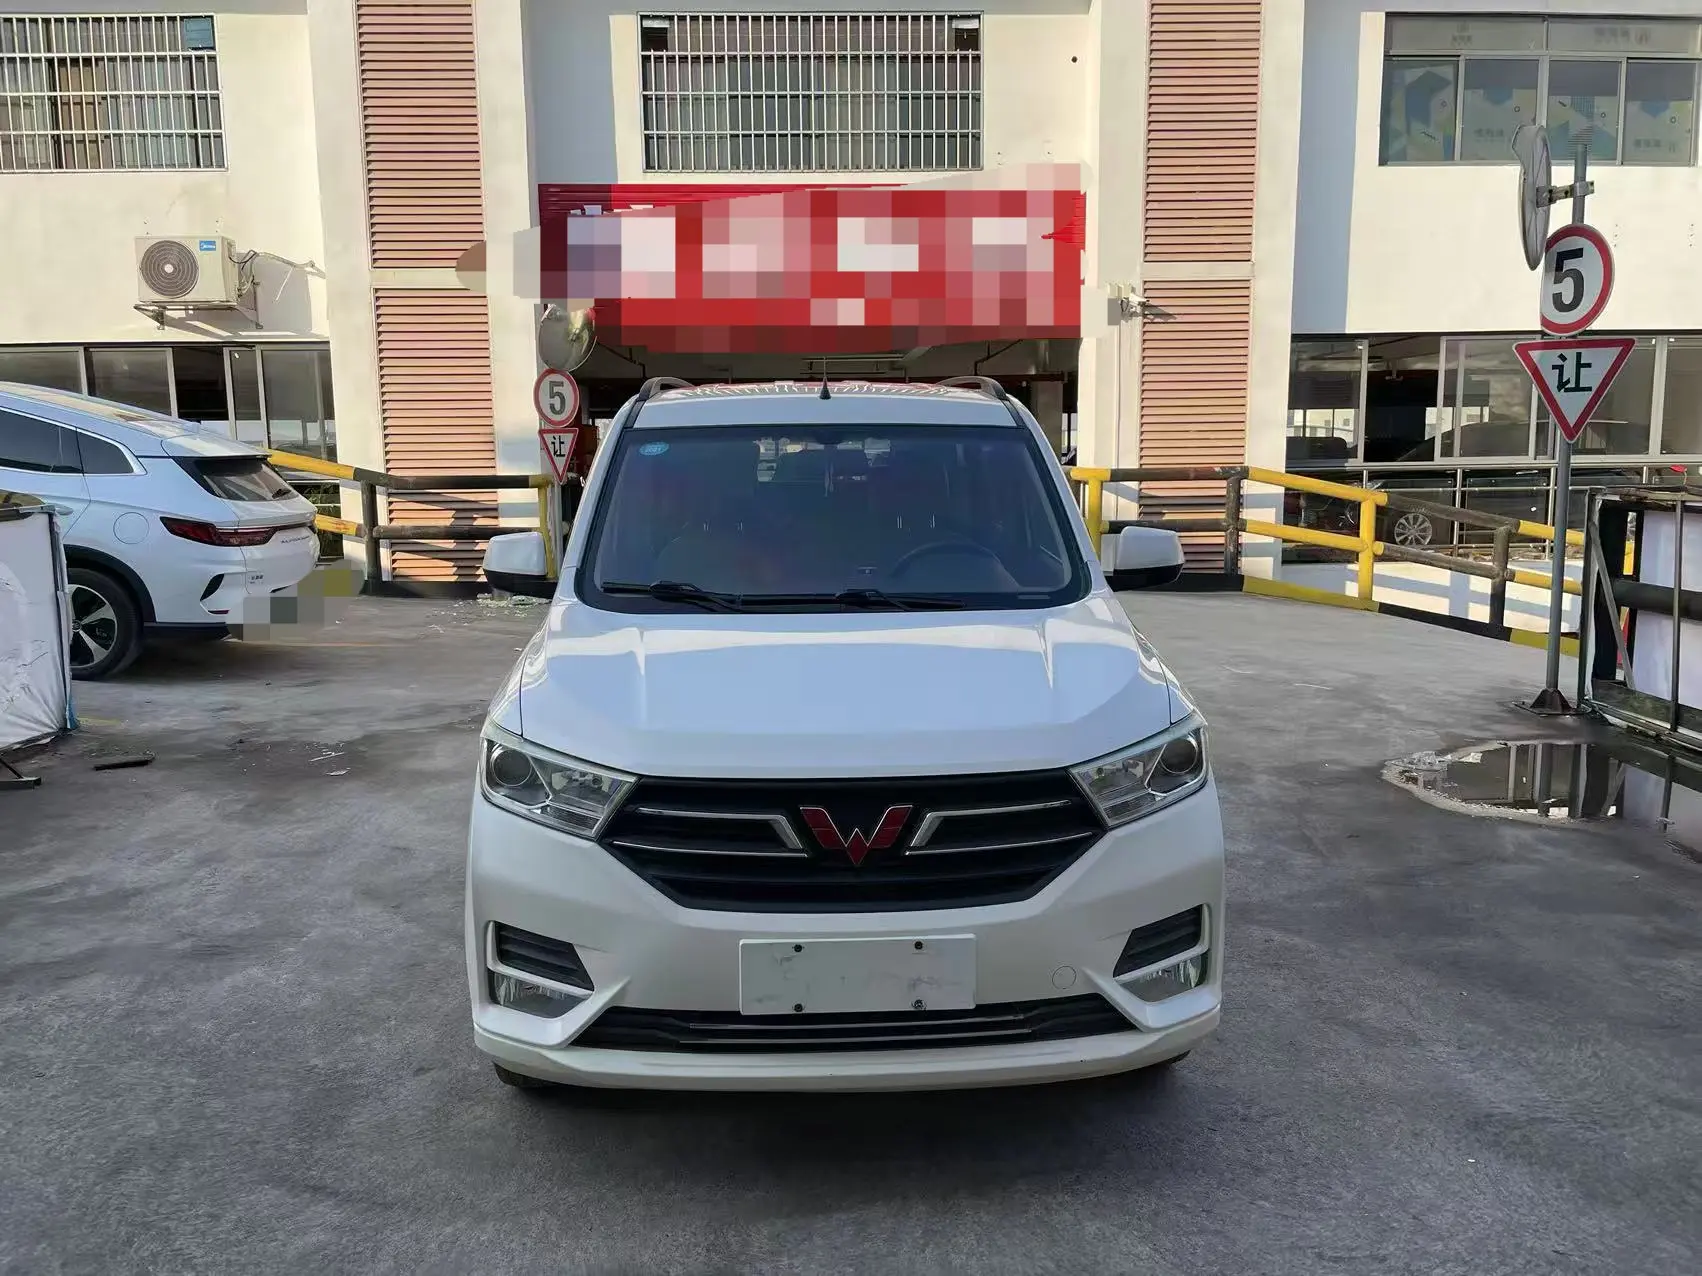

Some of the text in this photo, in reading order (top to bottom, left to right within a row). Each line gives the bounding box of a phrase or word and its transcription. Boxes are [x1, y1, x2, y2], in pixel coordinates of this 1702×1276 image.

[1552, 248, 1585, 313] 5
[1552, 352, 1592, 393] 让
[548, 381, 566, 415] 5
[551, 435, 566, 458] 让
